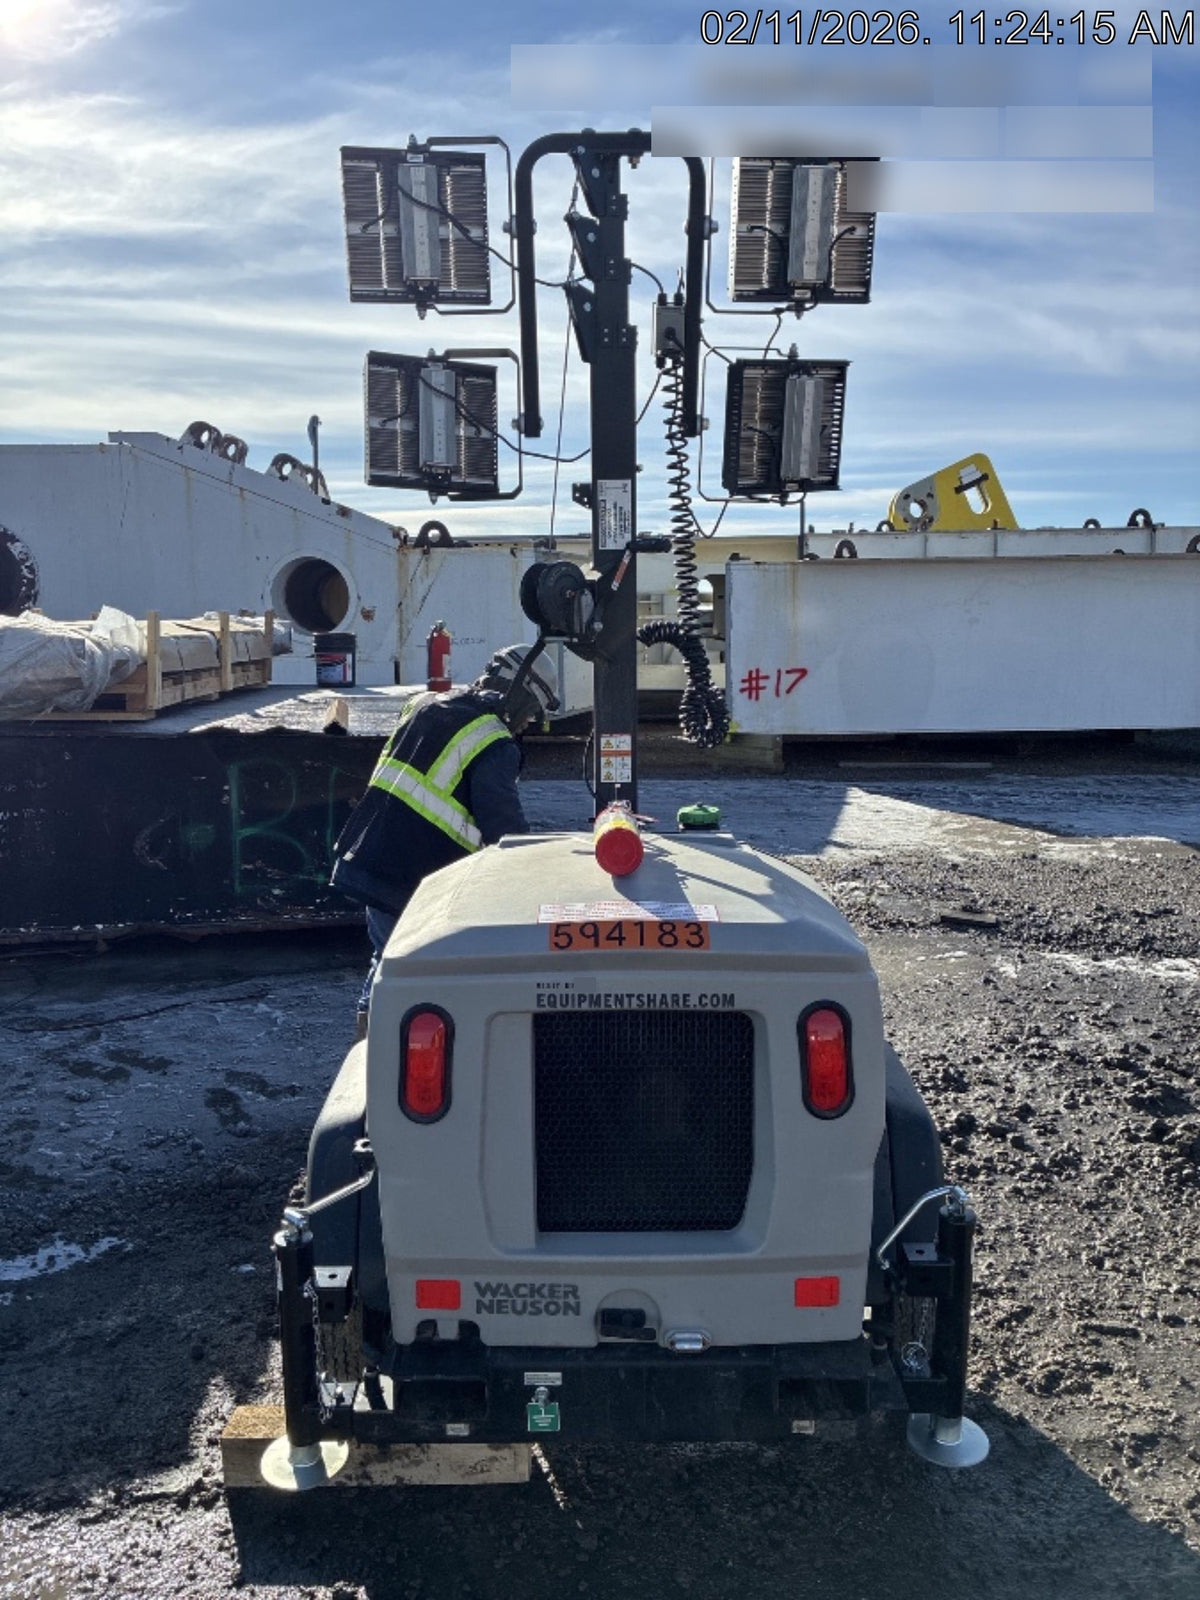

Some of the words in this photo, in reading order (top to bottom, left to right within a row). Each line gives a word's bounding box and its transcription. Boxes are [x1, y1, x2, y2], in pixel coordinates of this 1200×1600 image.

[739, 667, 809, 701] #17
[553, 920, 706, 950] 594183
[535, 992, 736, 1010] EQUIPMENTSHARE.COM
[474, 1281, 580, 1299] WACKER
[475, 1299, 581, 1316] NEUSON
